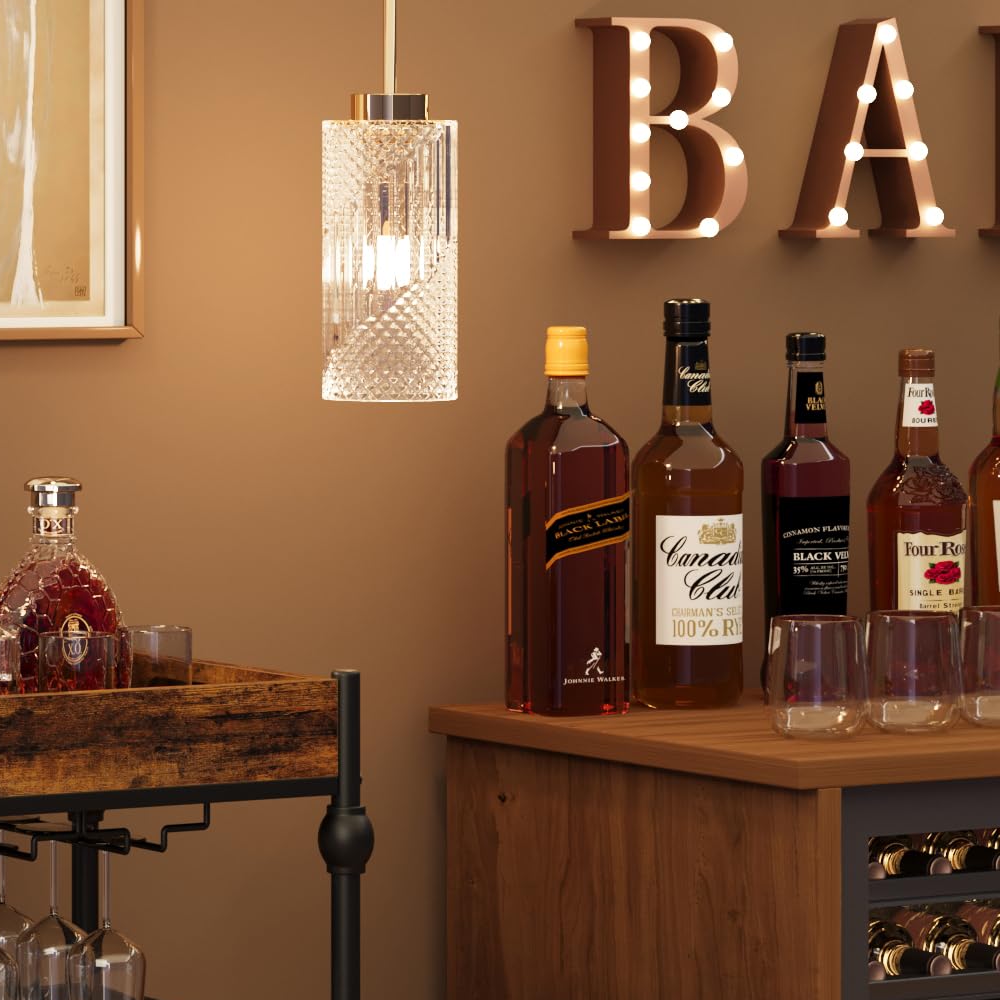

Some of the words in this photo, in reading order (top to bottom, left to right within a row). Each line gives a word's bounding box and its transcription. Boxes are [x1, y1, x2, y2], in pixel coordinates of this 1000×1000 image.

[573, 17, 1000, 240] BA
[783, 525, 821, 539] CINNAMON
[904, 541, 940, 557] Four
[793, 552, 832, 561] BLACK
[909, 589, 943, 597] SINGLE
[672, 618, 719, 638] 100%
[563, 677, 595, 685] JOHNNIE
